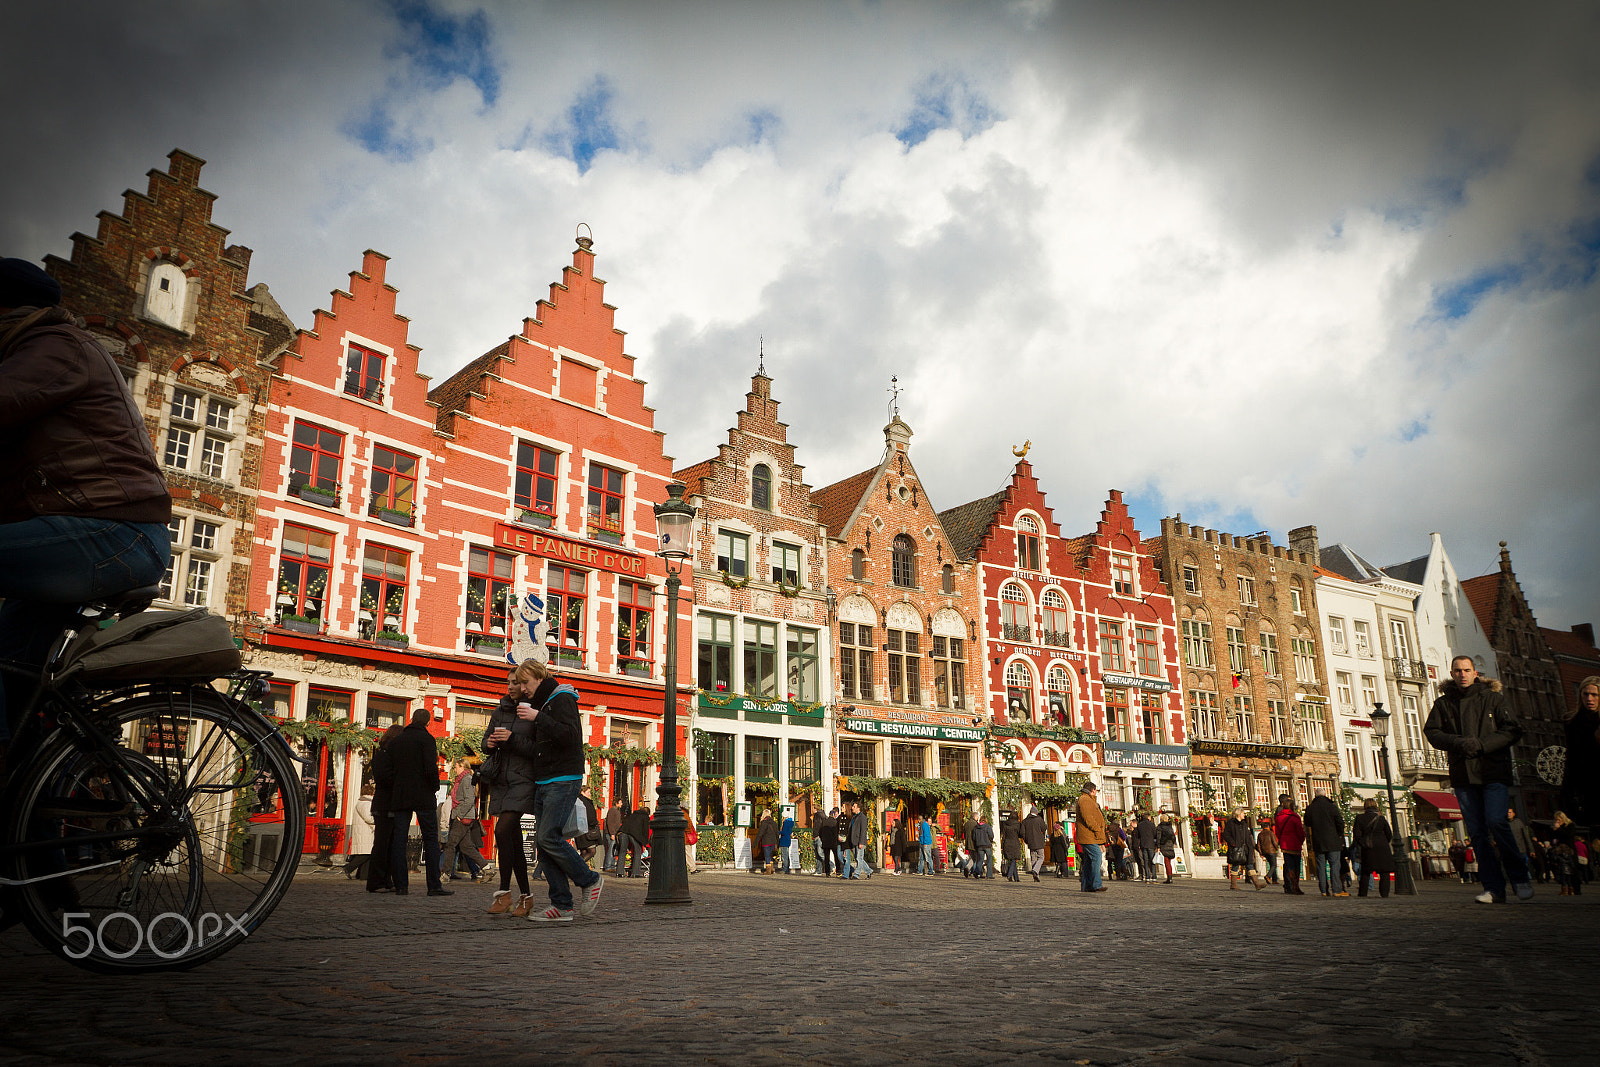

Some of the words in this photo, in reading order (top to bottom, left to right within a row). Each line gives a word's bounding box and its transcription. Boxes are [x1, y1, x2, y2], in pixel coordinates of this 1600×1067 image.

[503, 531, 527, 548] LE
[532, 534, 599, 564] PANIER
[604, 554, 642, 574] D'OR
[1104, 675, 1144, 686] RESTAURANT
[888, 711, 929, 721] RESTAURANT
[941, 716, 968, 725] CENTRAL
[848, 720, 878, 732] HOTEL
[881, 723, 938, 736] RESTAURANT
[941, 728, 986, 740] "CENTRAL"
[1200, 742, 1244, 752] RESTAURANT
